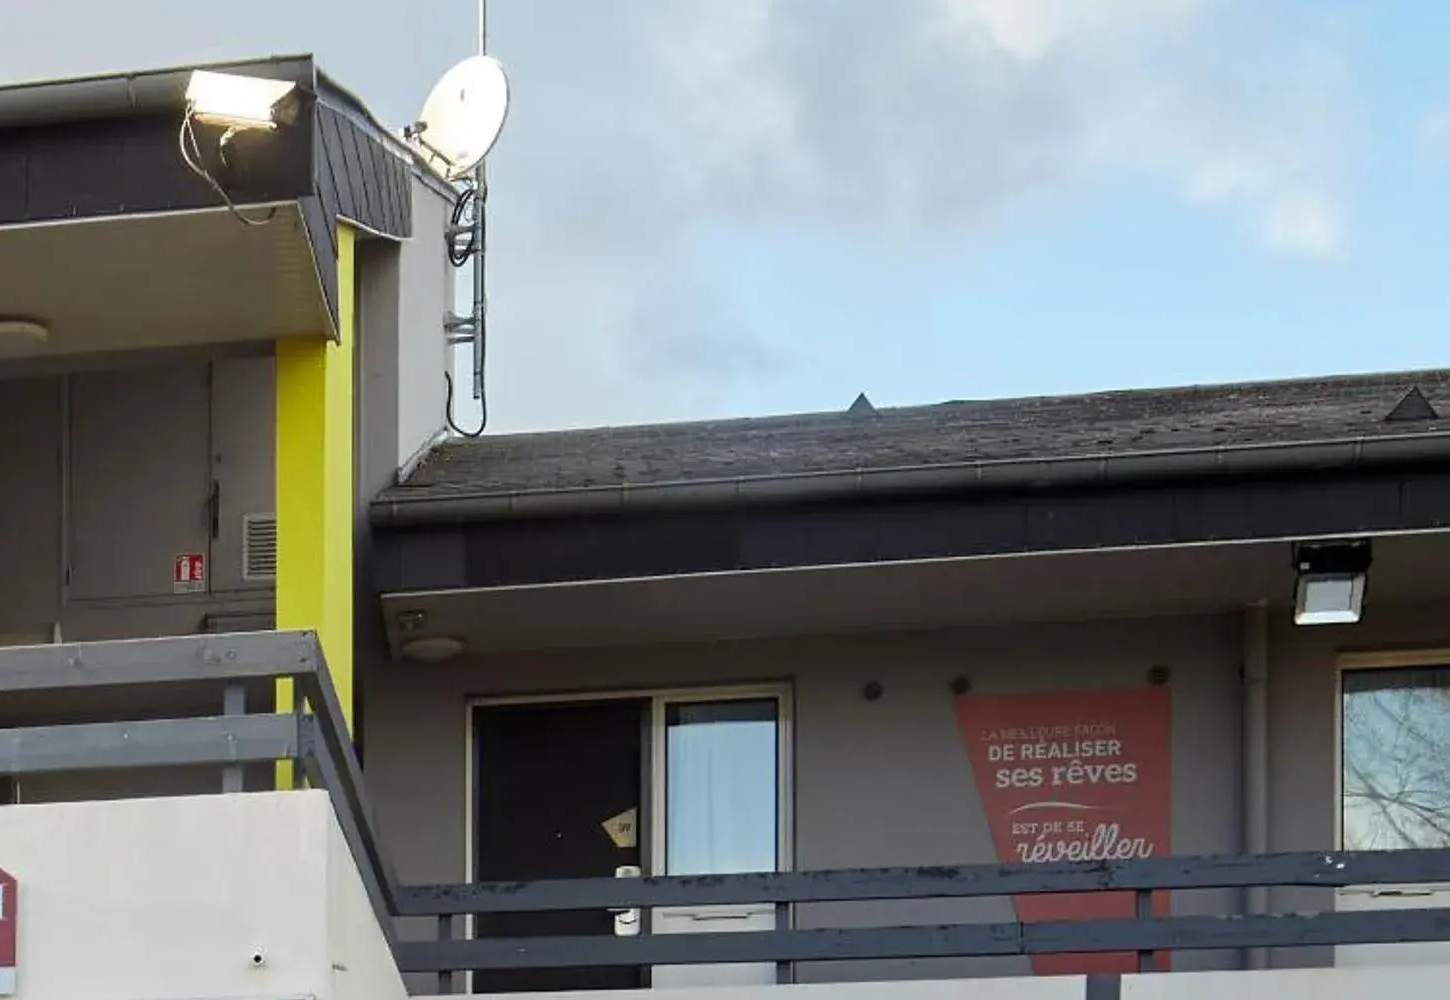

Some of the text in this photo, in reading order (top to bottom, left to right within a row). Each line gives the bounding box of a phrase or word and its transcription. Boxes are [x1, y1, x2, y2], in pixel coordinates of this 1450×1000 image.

[988, 739, 1123, 762] DE RÉALISER
[996, 760, 1138, 788] ses rêves
[1012, 822, 1039, 835] EST
[1066, 821, 1085, 833] SE
[1016, 823, 1154, 864] réveiller
